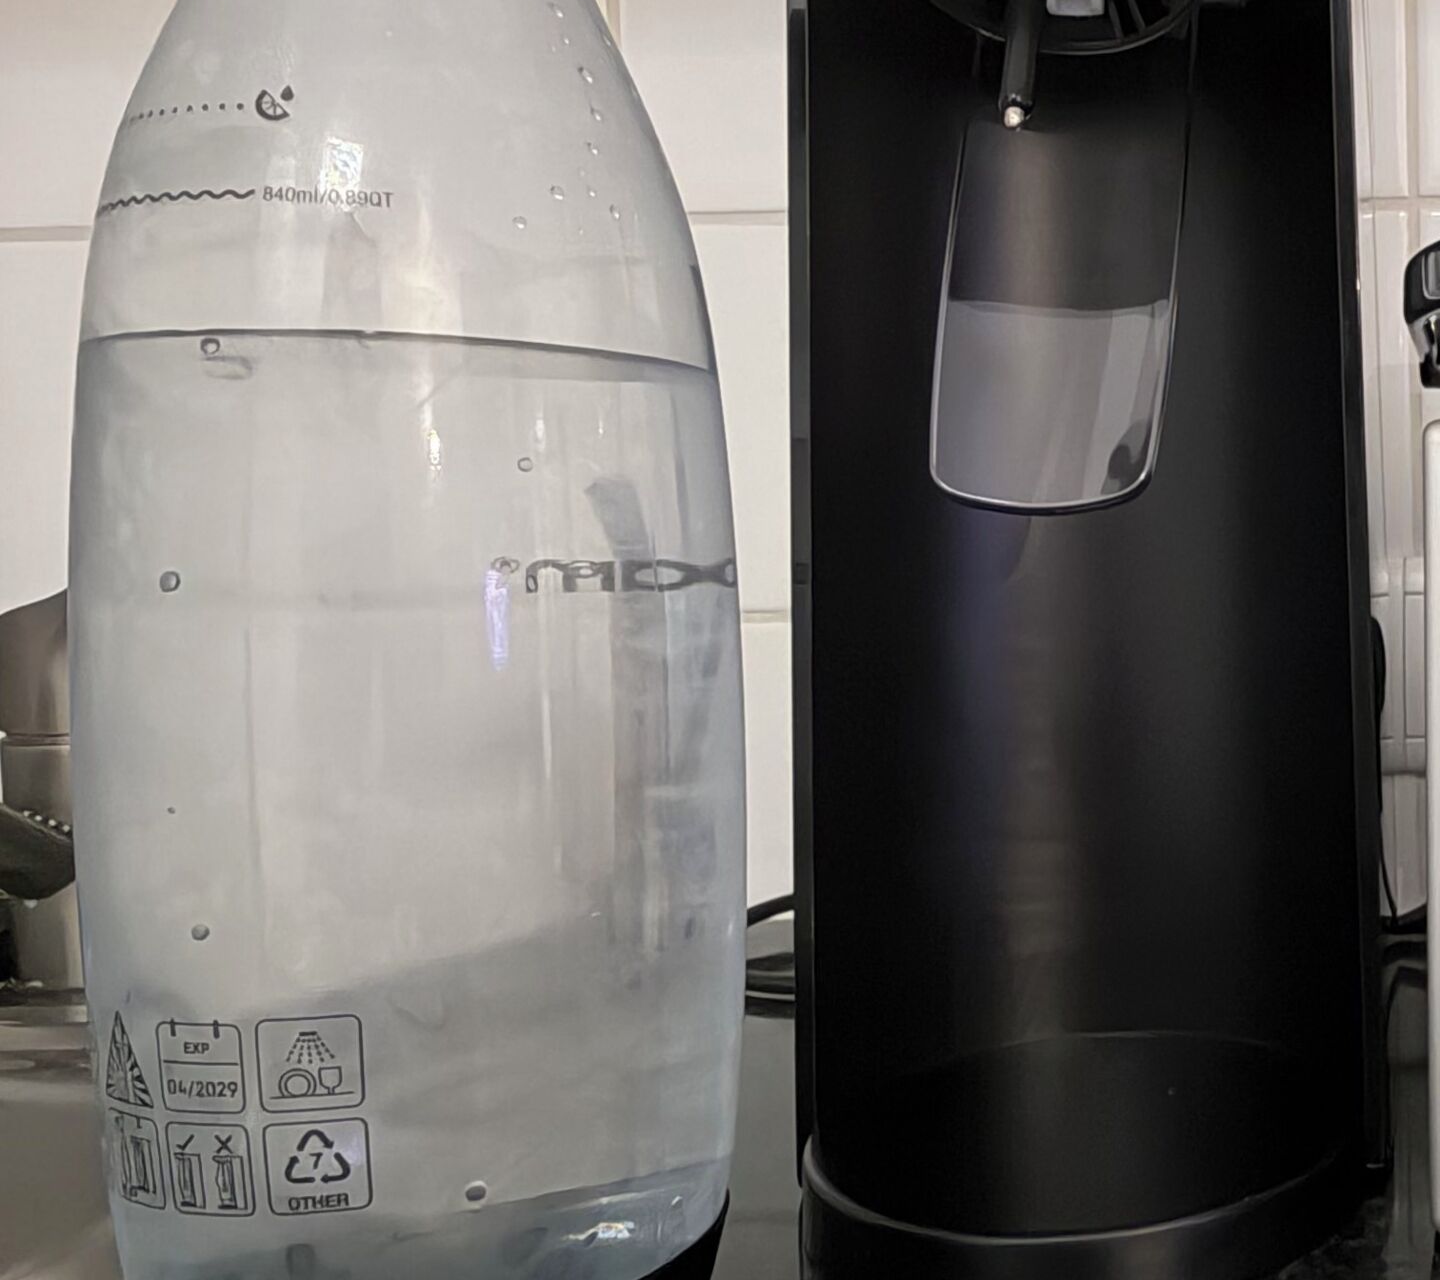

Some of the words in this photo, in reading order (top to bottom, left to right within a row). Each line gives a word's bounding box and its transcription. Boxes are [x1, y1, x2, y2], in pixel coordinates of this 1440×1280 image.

[183, 1042, 210, 1055] EXP
[167, 1078, 238, 1098] 04/2029
[309, 1152, 323, 1169] 7
[288, 1192, 350, 1212] OTHER
